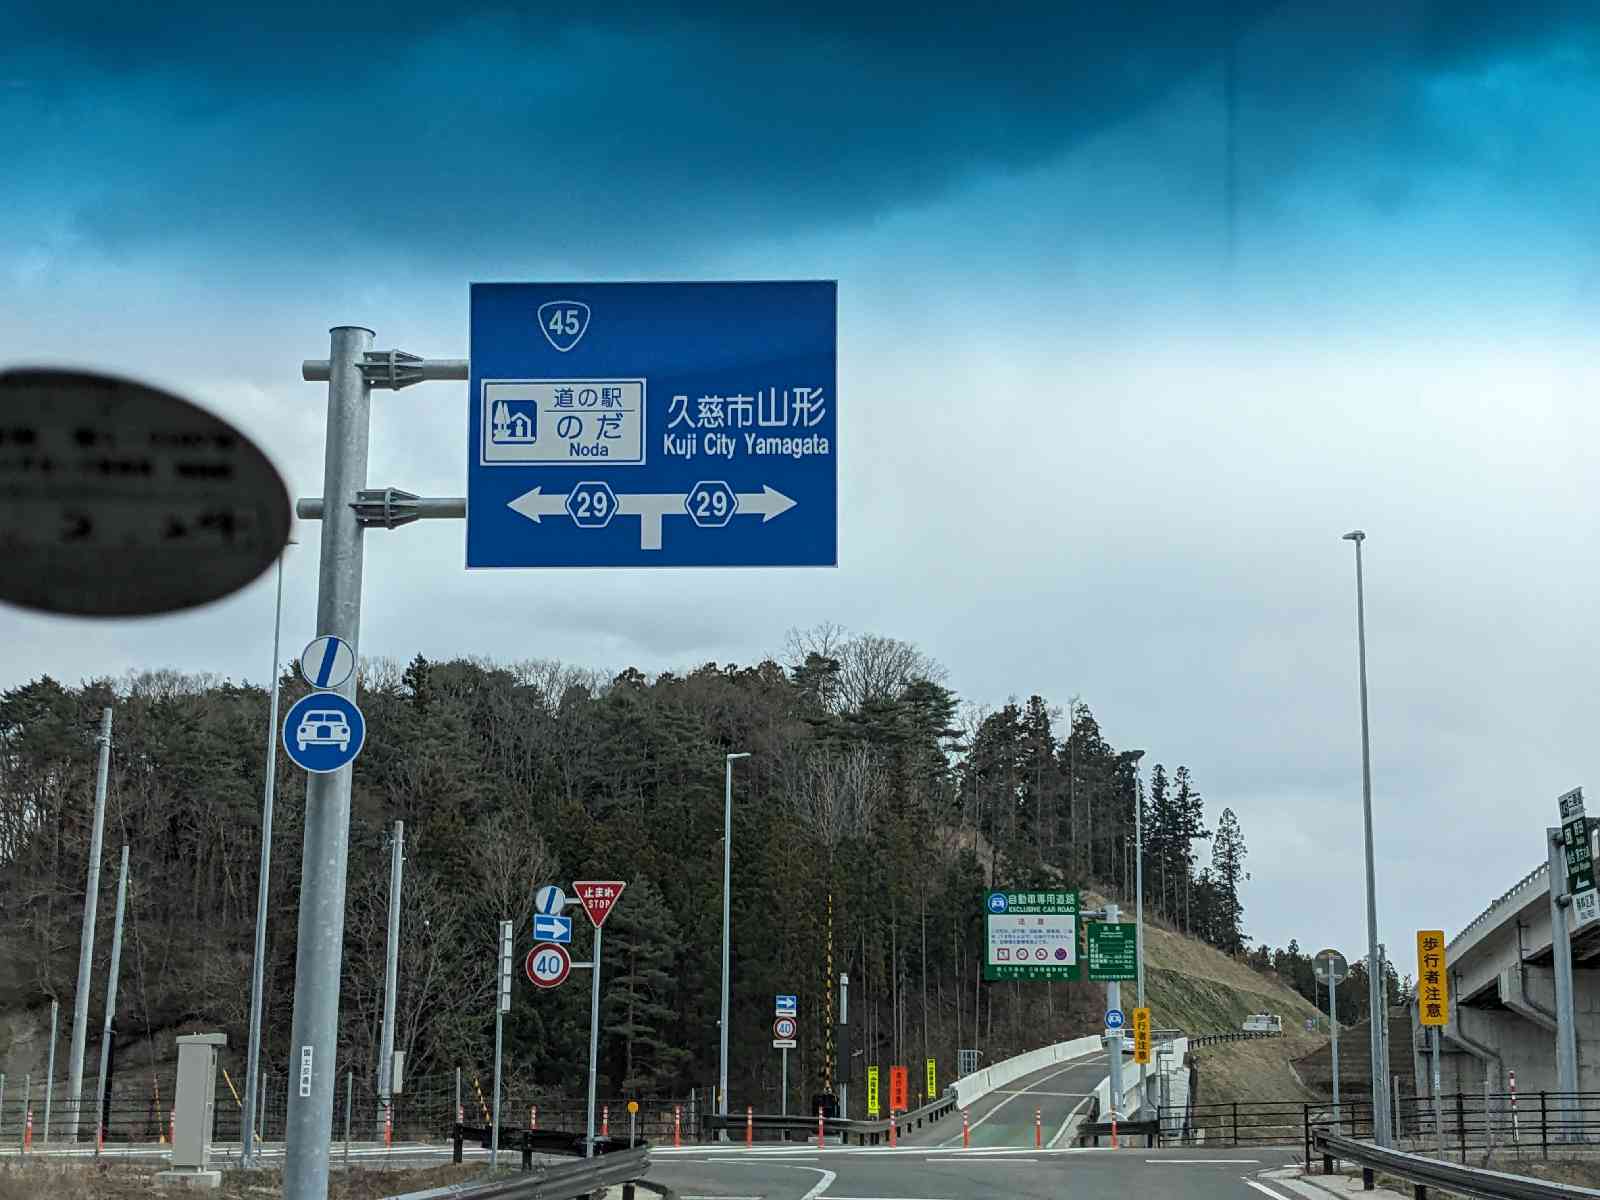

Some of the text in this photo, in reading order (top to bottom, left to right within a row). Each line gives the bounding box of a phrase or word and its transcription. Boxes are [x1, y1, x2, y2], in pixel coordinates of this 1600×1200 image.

[549, 310, 580, 335] 45
[553, 387, 623, 408] 道の駅
[667, 386, 827, 429] 久慈市山形
[556, 413, 624, 441] のだ
[569, 442, 609, 457] Noda
[663, 432, 830, 459] Kuji City Yamagata
[576, 491, 608, 518] 29
[696, 491, 728, 518] 29
[583, 887, 615, 898] 止まれ
[588, 899, 611, 909] STOP
[536, 955, 561, 975] 40
[1422, 936, 1442, 1018] 歩行者注意
[778, 1023, 791, 1033] 40
